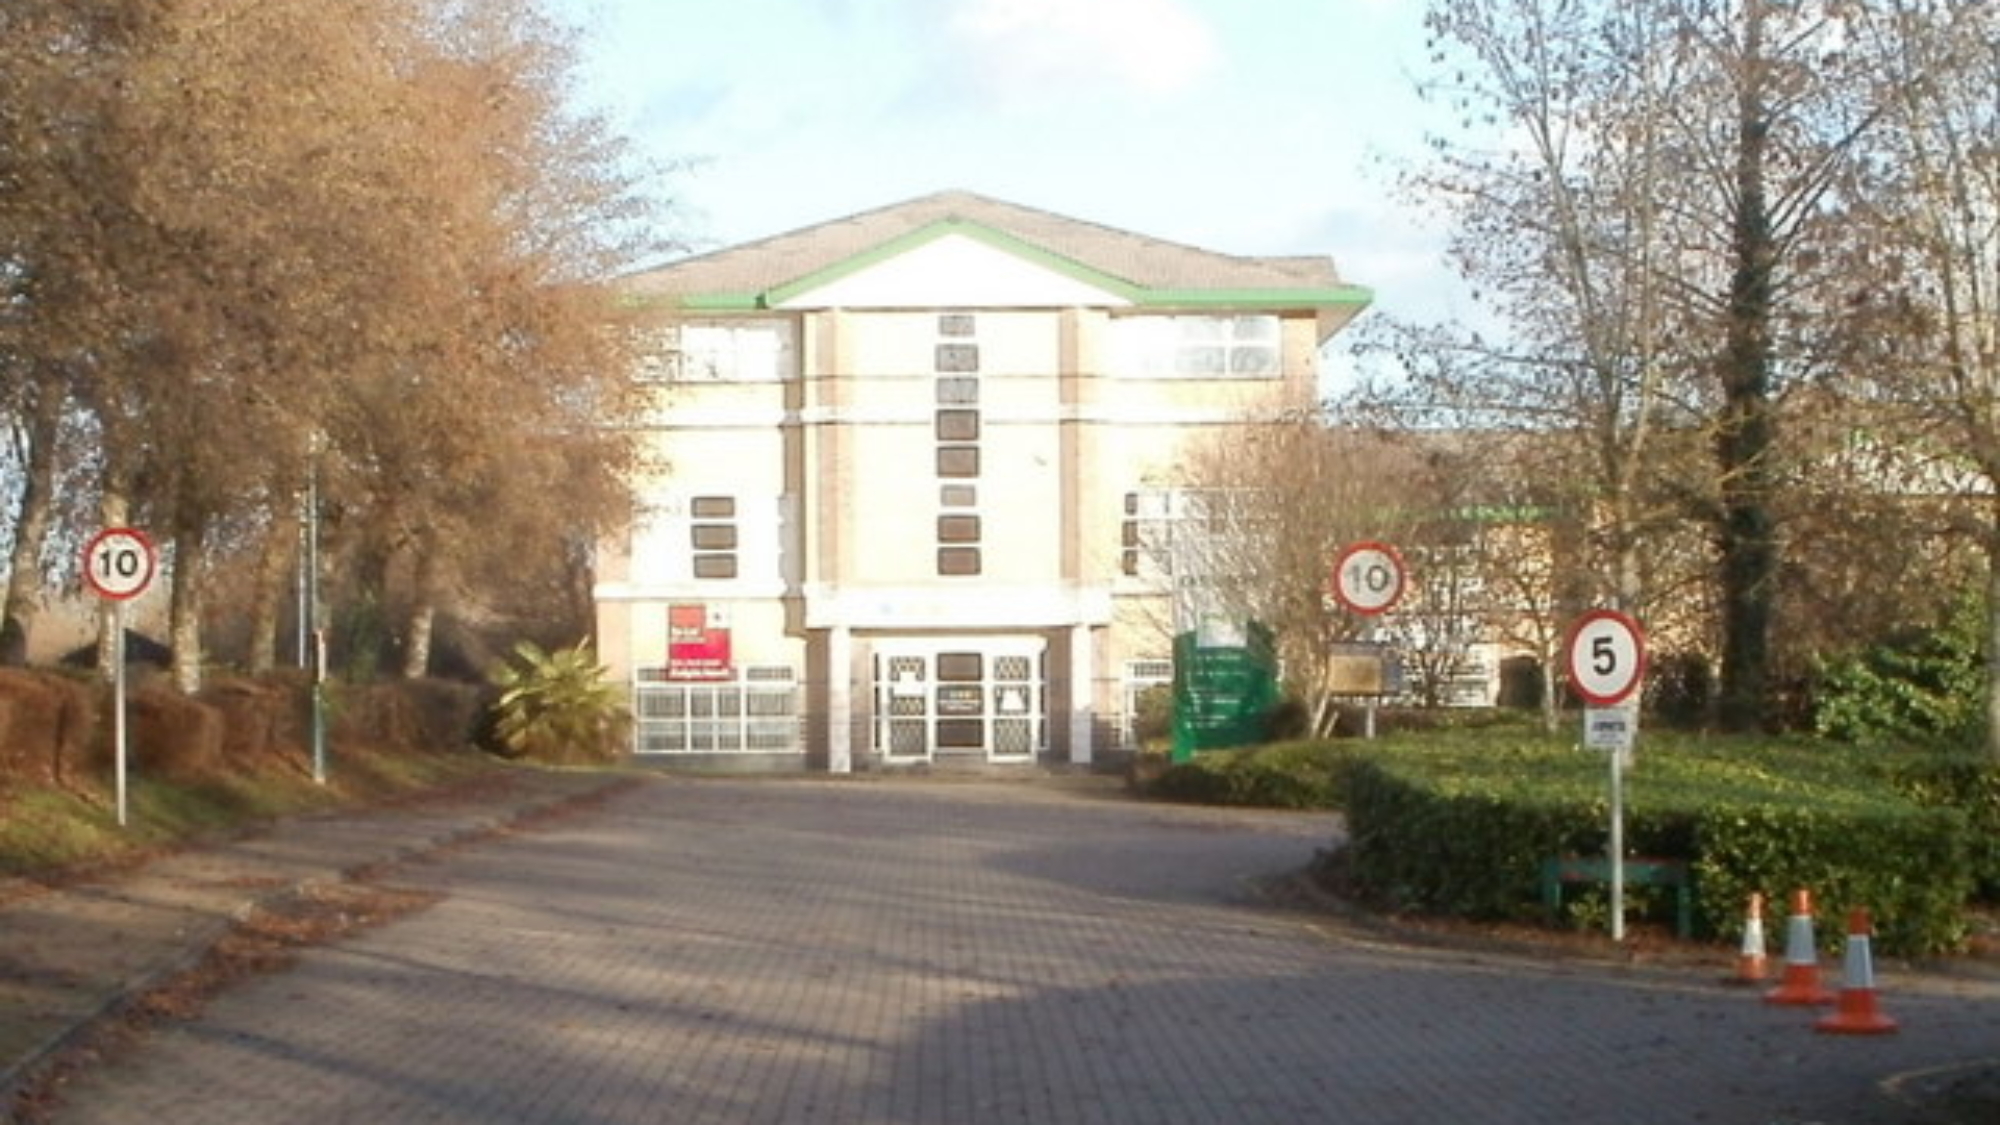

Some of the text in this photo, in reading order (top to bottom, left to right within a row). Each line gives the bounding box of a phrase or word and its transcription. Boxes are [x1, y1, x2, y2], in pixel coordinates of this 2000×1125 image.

[100, 549, 138, 577] 10
[1352, 565, 1388, 593] 10
[1592, 636, 1616, 676] 5
